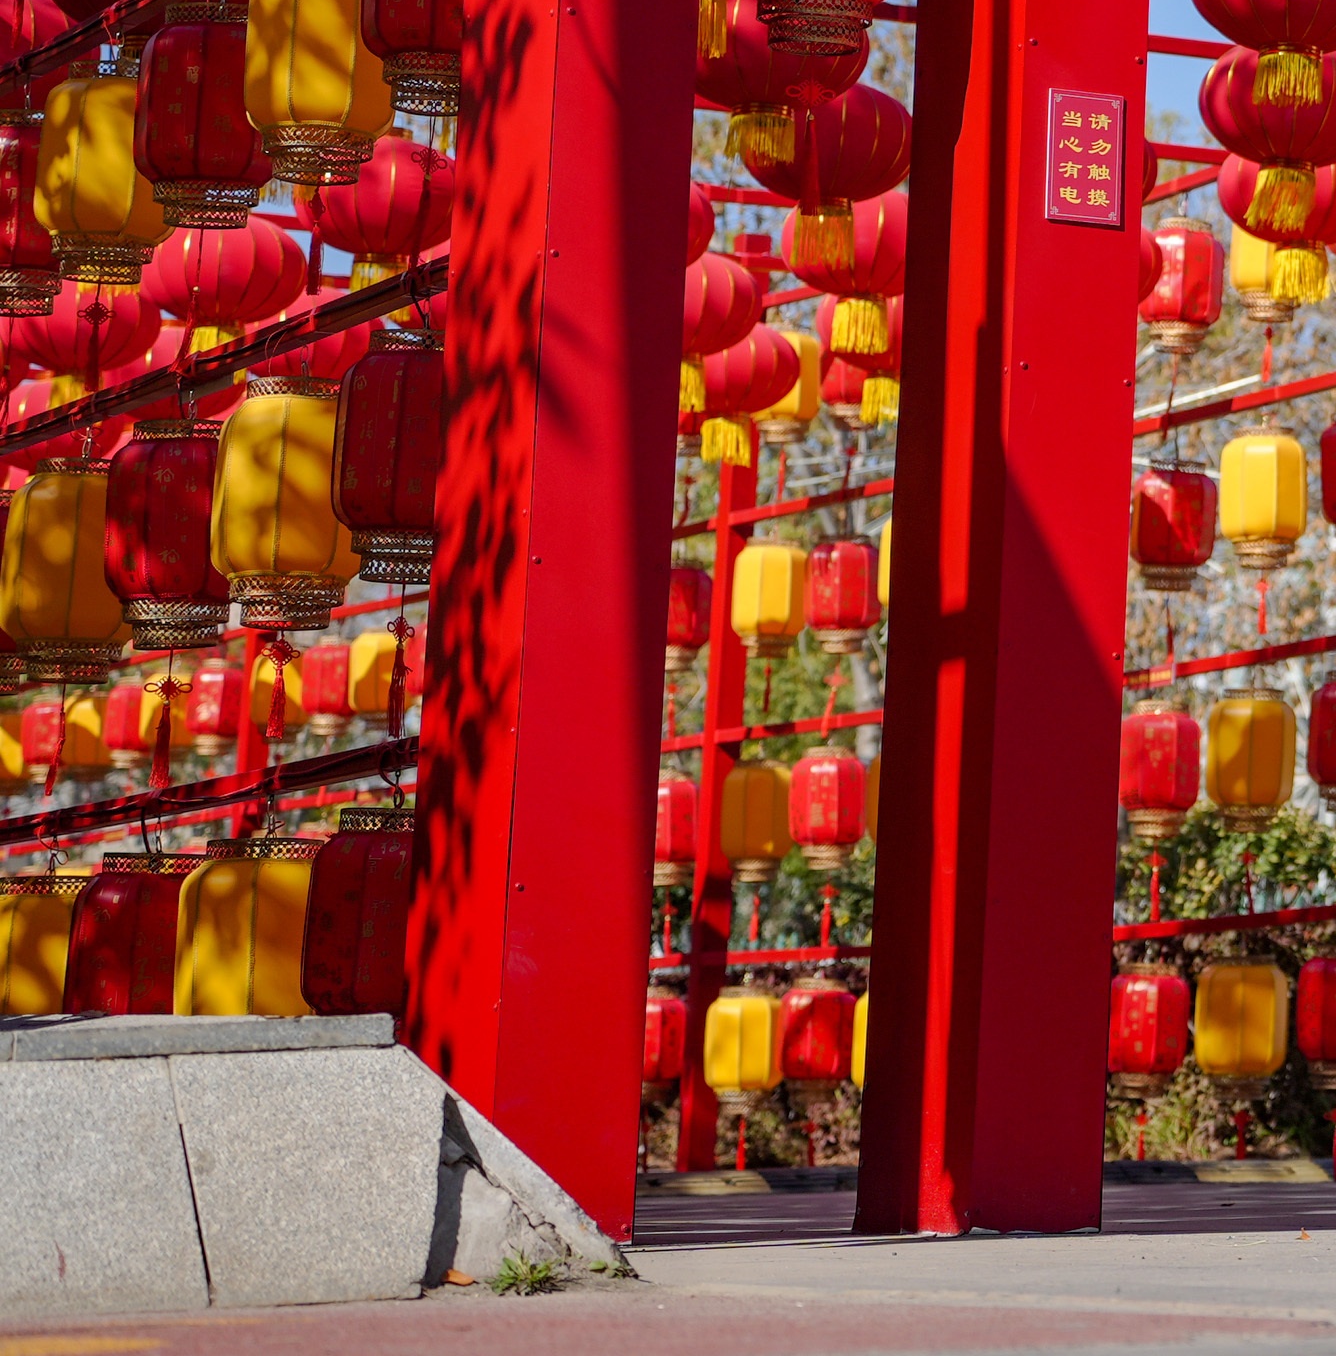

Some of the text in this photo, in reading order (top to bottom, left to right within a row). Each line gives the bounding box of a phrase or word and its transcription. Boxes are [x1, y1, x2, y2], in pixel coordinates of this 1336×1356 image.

[1058, 111, 1083, 204] 当心有电
[1086, 114, 1112, 207] 请勿触摸
